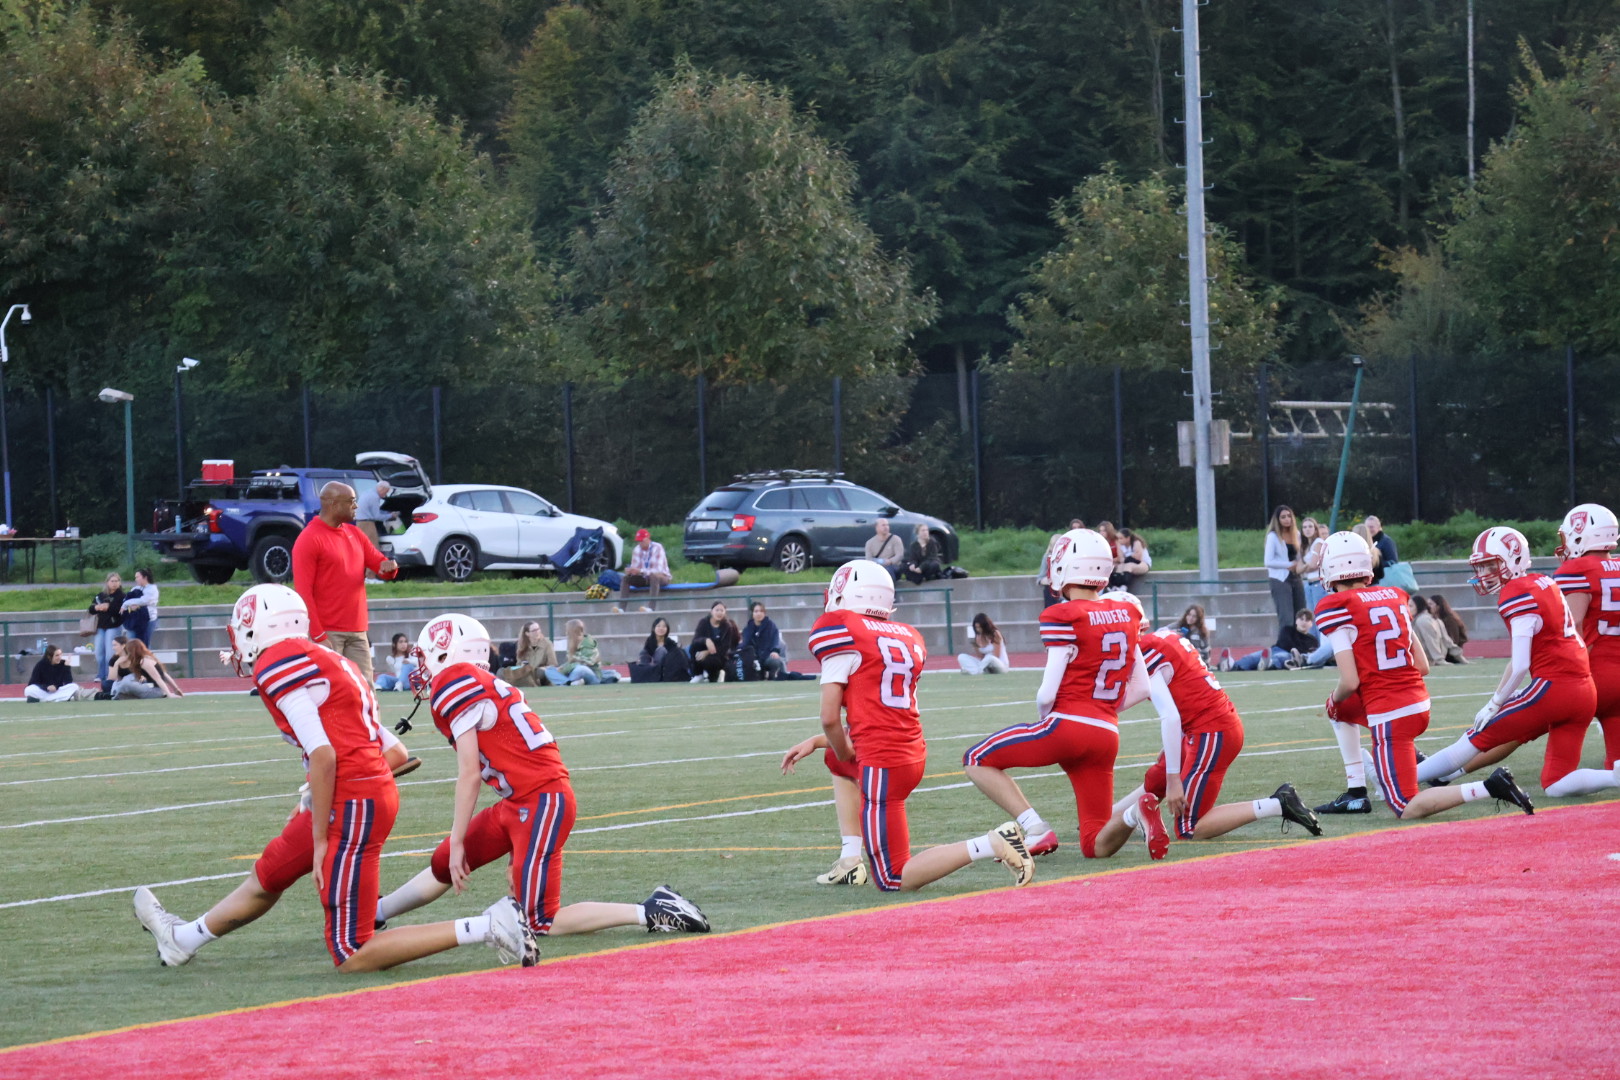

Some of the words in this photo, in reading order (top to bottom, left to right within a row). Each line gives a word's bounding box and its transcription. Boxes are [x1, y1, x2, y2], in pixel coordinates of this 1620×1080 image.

[1356, 589, 1399, 603] RAIDERS
[862, 618, 913, 638] RAIDERS
[1087, 608, 1131, 626] RAIDERS
[1368, 605, 1415, 671] 21
[1092, 630, 1128, 700] 2
[998, 827, 1030, 860] NIKE
